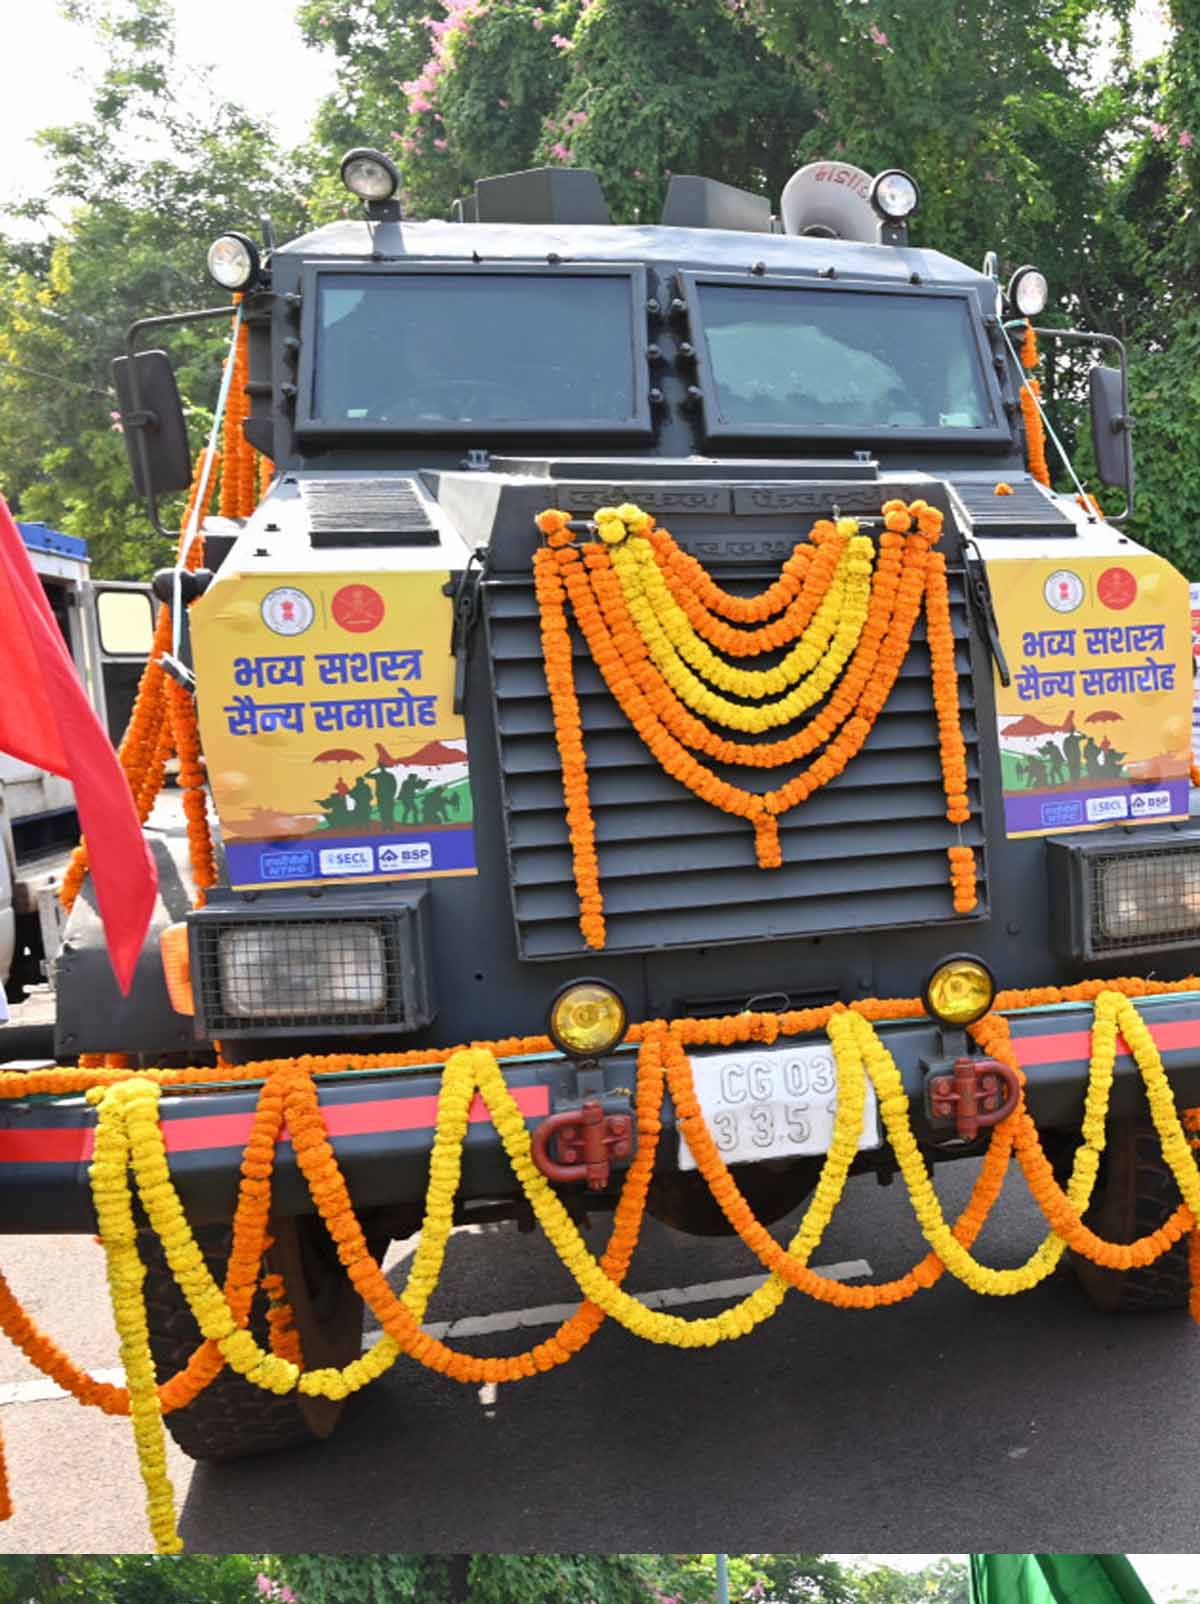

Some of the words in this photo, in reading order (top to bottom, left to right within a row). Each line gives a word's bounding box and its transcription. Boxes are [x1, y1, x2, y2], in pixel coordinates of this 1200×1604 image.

[1022, 629, 1077, 658] भव्य
[1083, 623, 1166, 655] सशस्त्र
[233, 655, 305, 689] भव्य
[314, 650, 423, 685] सशस्त्र
[1014, 664, 1076, 701] सैन्य
[1080, 656, 1176, 696] समारोह
[223, 695, 305, 736] सैन्य
[310, 688, 438, 732] समारोह
[336, 852, 368, 865] SECL
[401, 849, 430, 861] BSP
